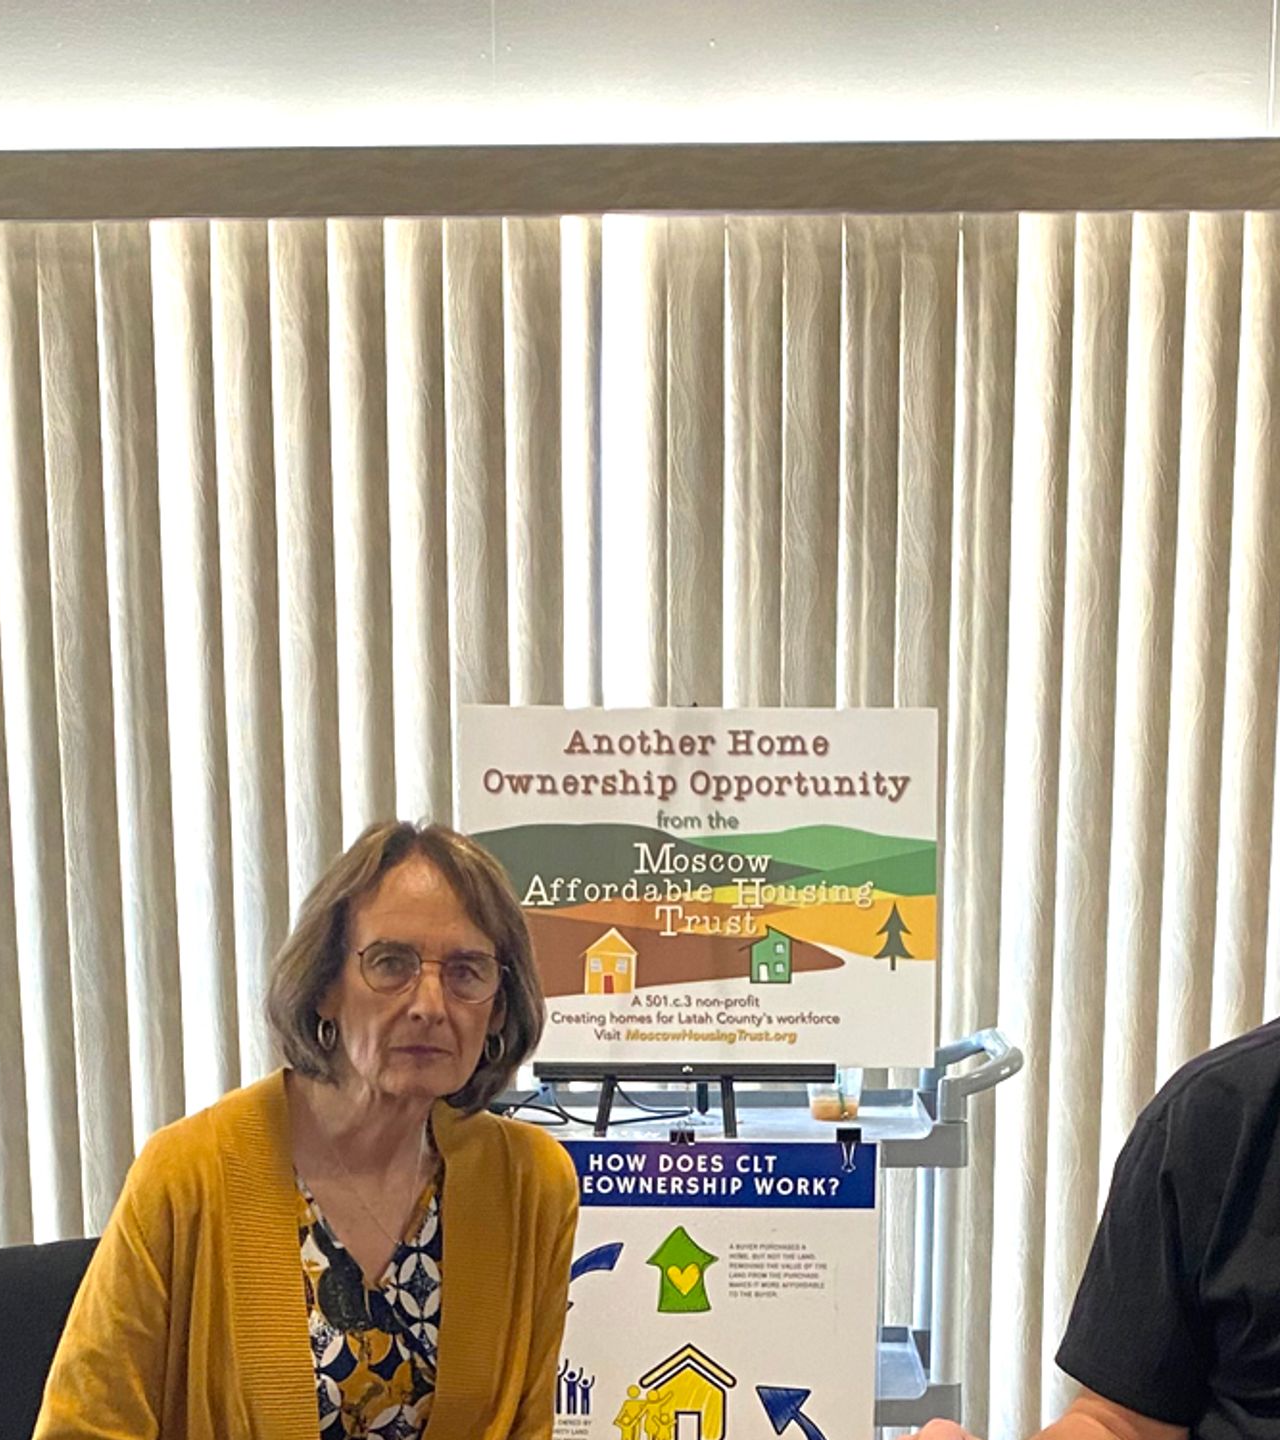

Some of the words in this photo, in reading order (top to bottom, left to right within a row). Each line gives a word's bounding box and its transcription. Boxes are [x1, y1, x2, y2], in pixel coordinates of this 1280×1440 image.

[564, 729, 715, 756] Another
[728, 731, 829, 756] Home
[483, 769, 677, 800] Ownership
[689, 771, 909, 801] Opportunity
[657, 811, 701, 829] from
[709, 811, 739, 829] the
[634, 843, 771, 875] Moscow
[521, 875, 713, 906] Affordable
[732, 878, 874, 908] Housing
[656, 905, 757, 936] Trust
[631, 996, 643, 1007] A
[696, 995, 759, 1009] non-profit
[551, 1013, 607, 1027] Creating
[610, 1012, 652, 1024] homes
[656, 1012, 674, 1024] for
[679, 1012, 713, 1024] Latah
[717, 1012, 773, 1027] County's
[777, 1012, 840, 1024] workforce
[595, 1029, 620, 1041] Visit
[590, 1154, 646, 1170] HOW
[659, 1154, 724, 1171] DOES
[737, 1155, 777, 1172] CLT
[583, 1177, 743, 1196] EOWNERSHIP
[755, 1177, 840, 1196] WORK?
